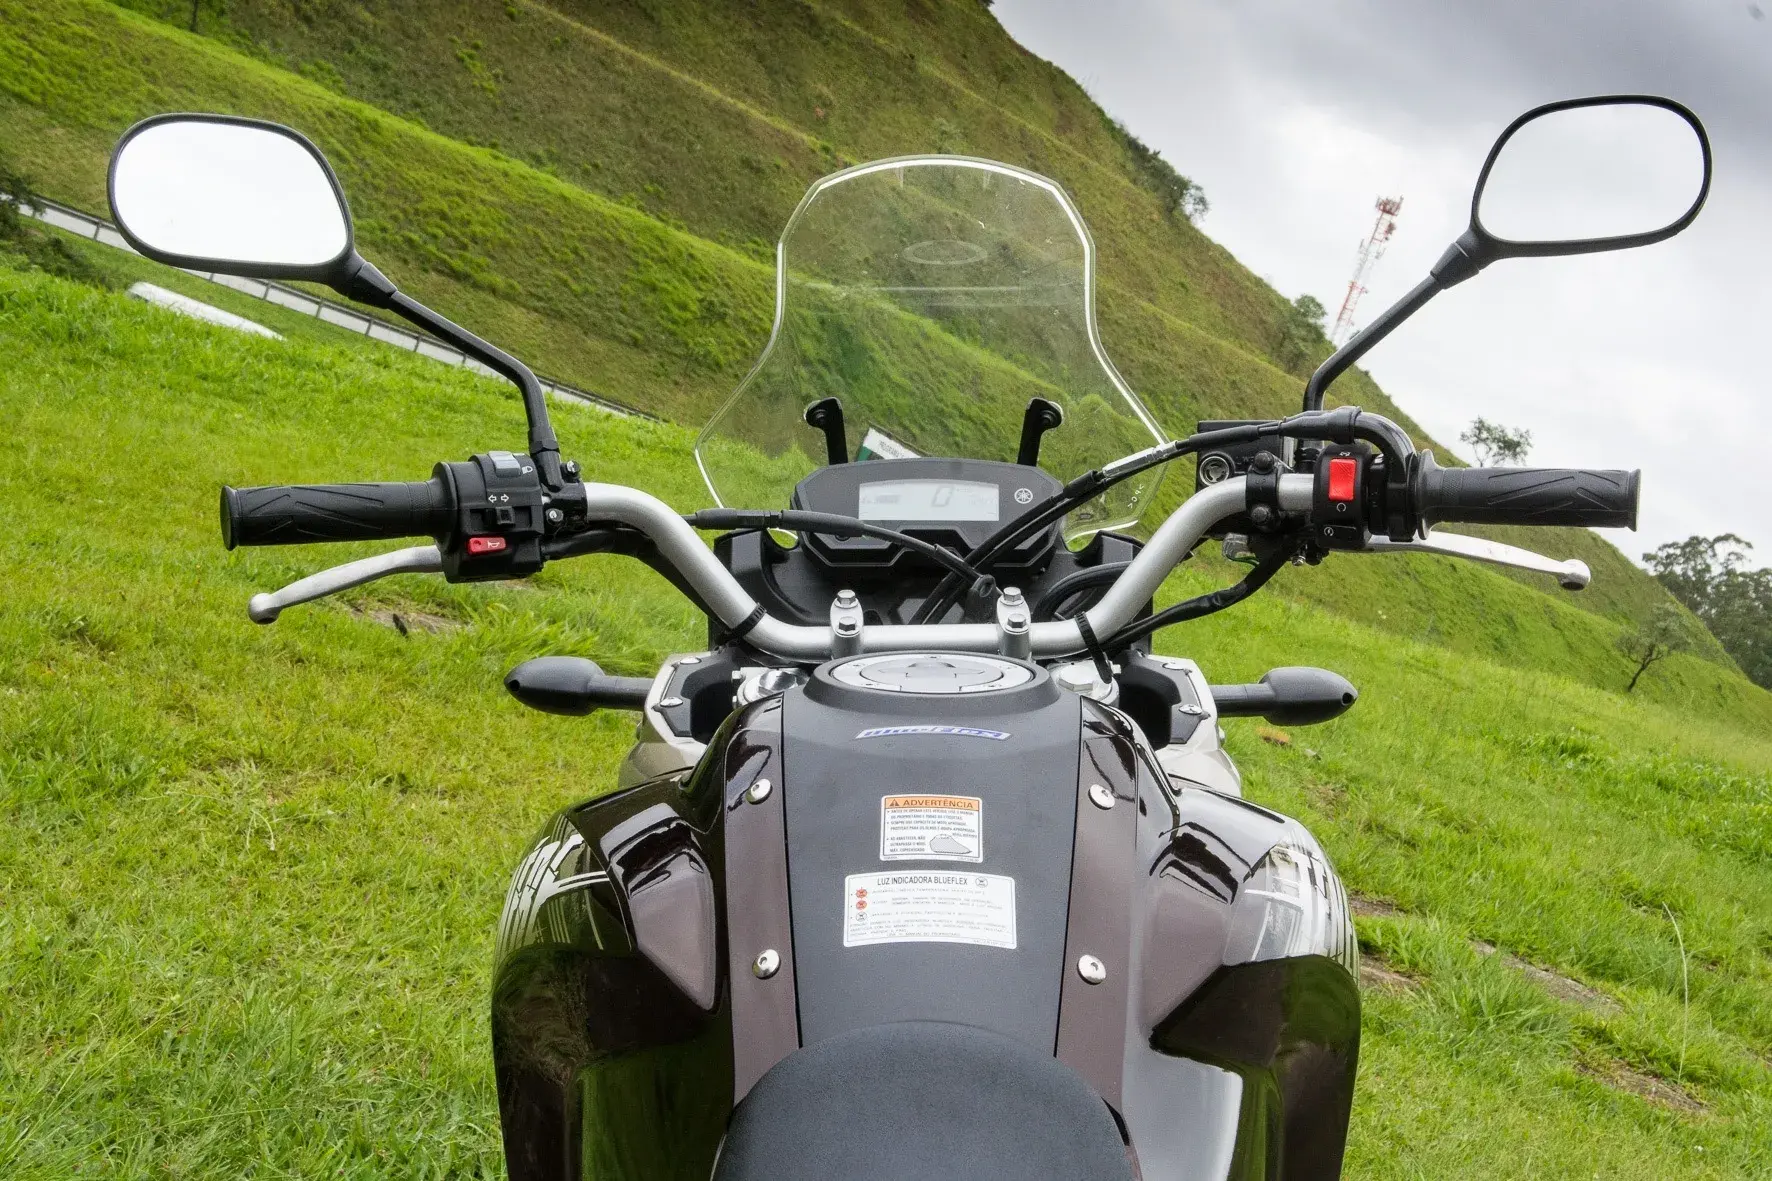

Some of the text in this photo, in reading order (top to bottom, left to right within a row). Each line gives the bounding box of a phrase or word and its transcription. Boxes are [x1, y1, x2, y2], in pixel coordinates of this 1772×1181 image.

[903, 799, 974, 808] ADVERTÊNCIA
[877, 876, 968, 886] LUZ INDICADORA BLUEFLEX
